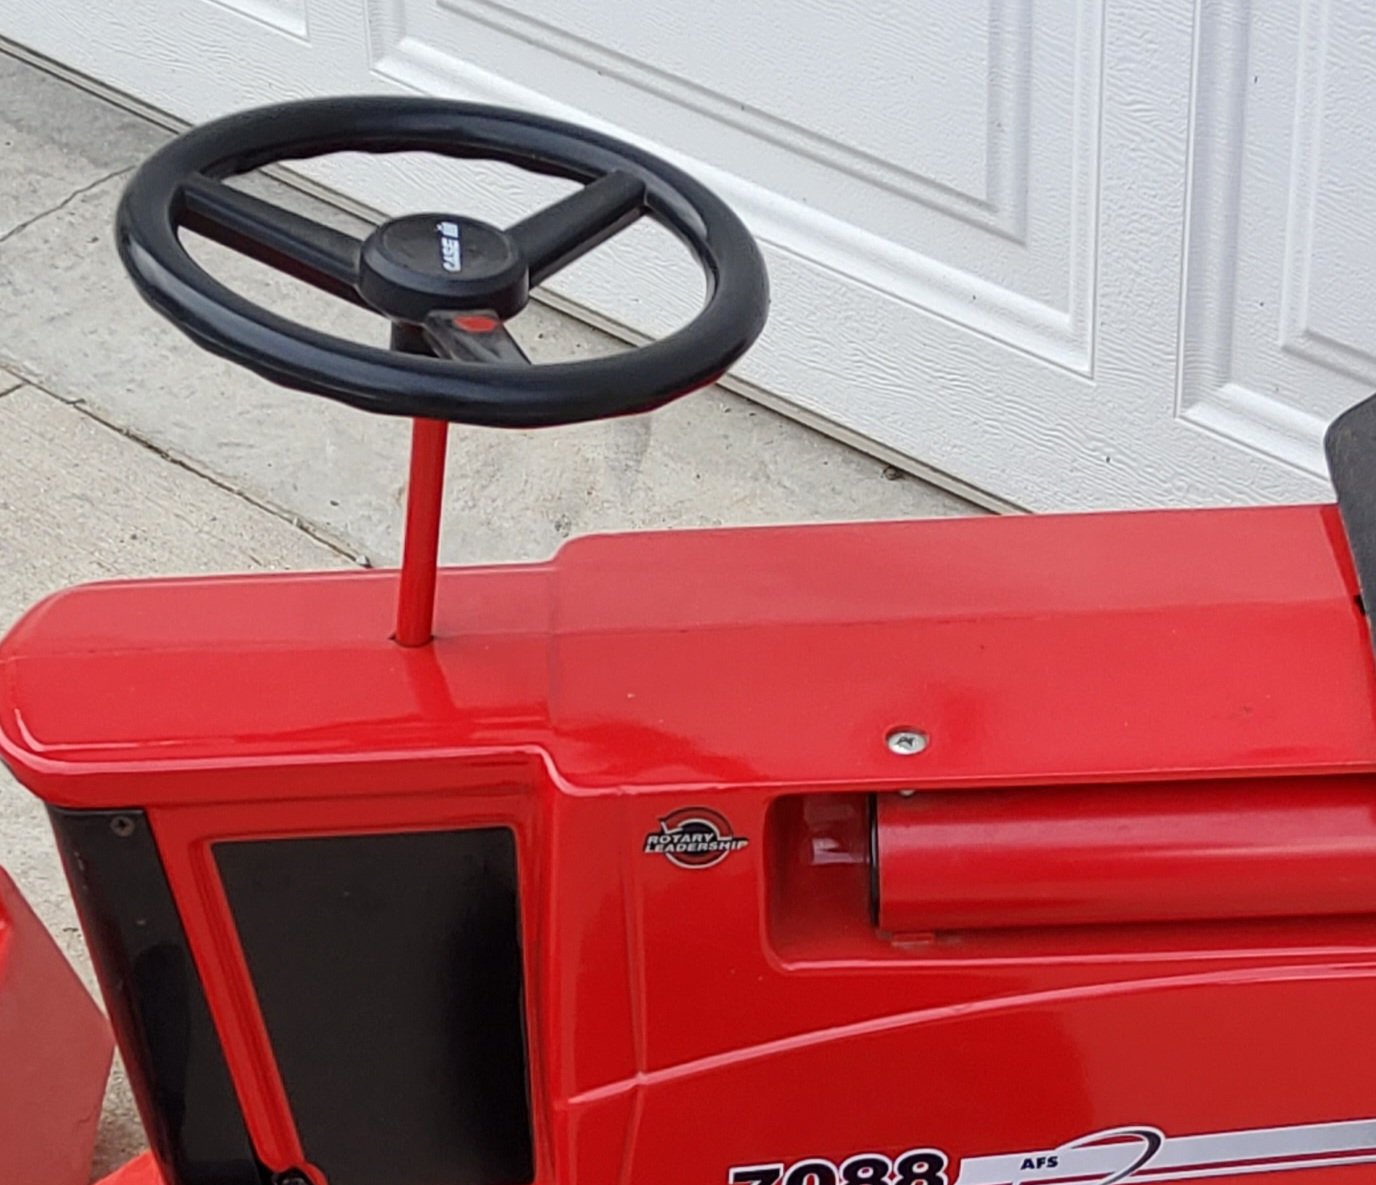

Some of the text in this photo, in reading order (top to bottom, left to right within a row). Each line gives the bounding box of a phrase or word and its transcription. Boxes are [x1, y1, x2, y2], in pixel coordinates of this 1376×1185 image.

[647, 832, 715, 844] ROTARY
[644, 840, 749, 853] LEADERSHIP
[1019, 1155, 1058, 1170] AFS
